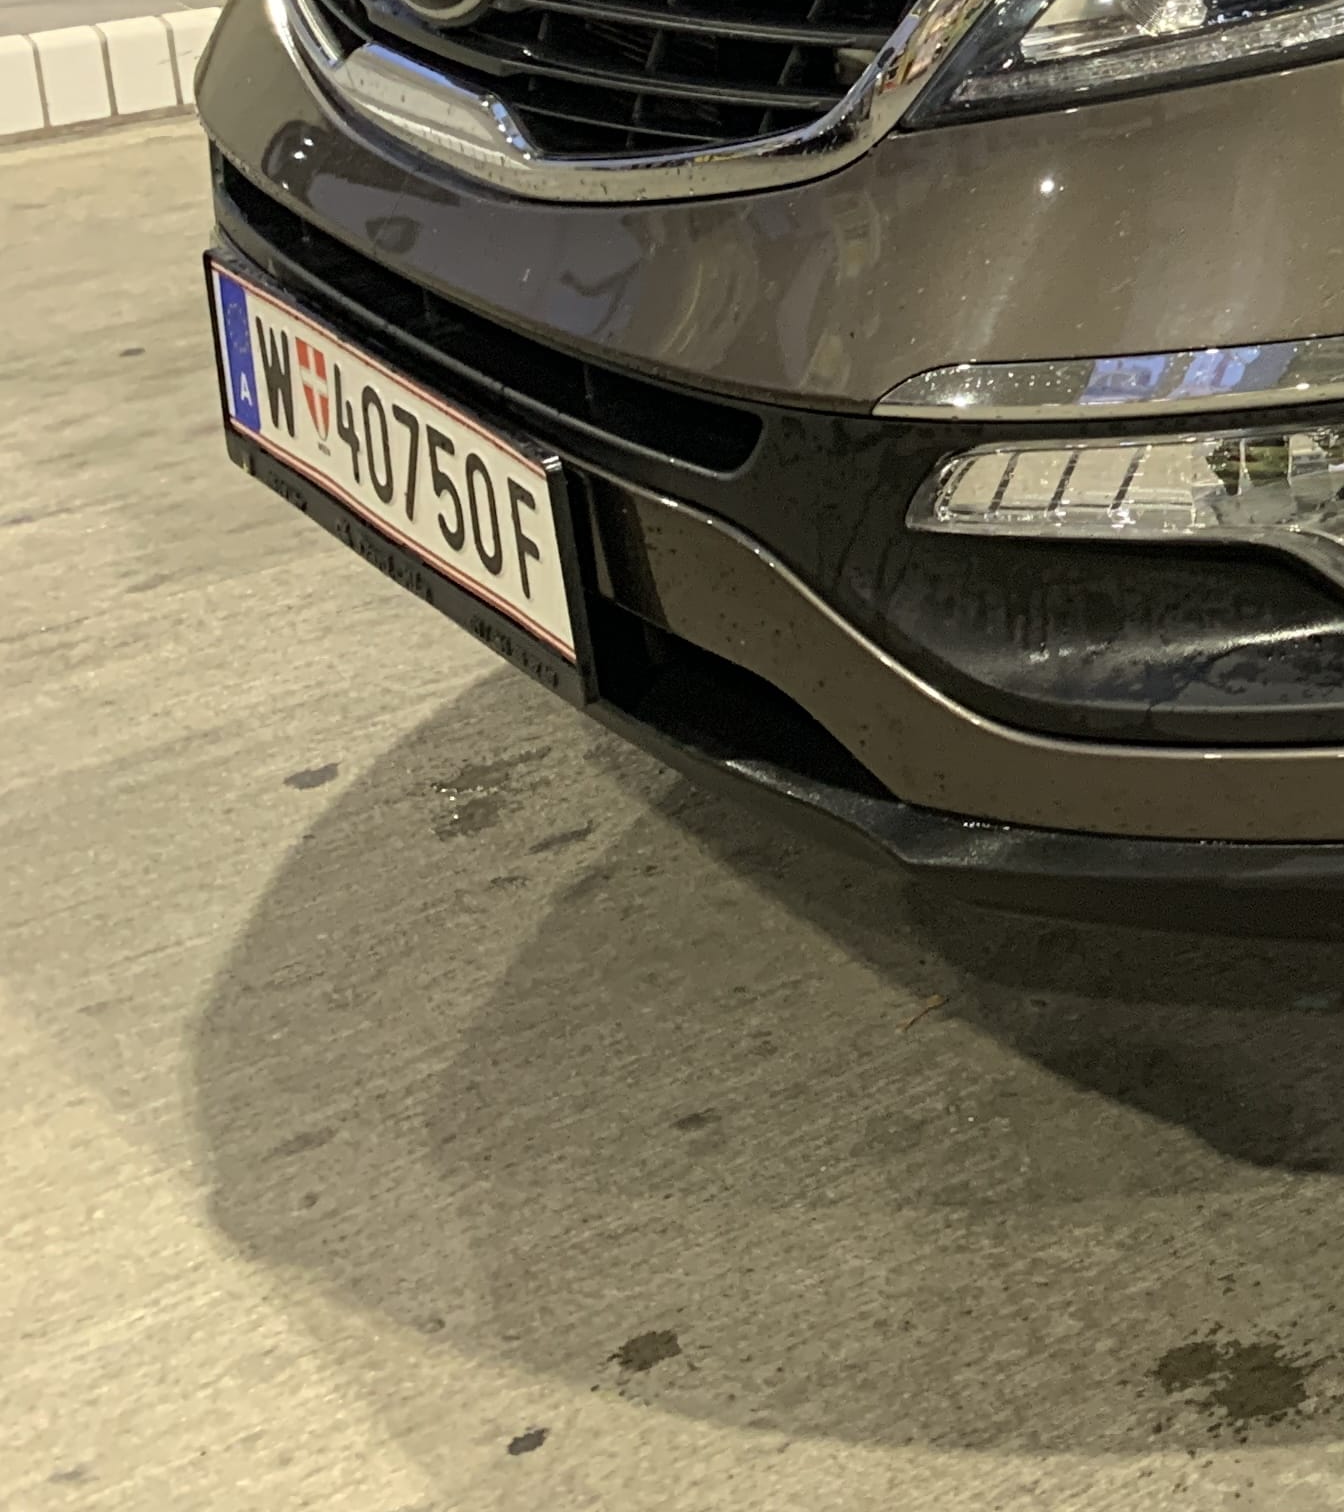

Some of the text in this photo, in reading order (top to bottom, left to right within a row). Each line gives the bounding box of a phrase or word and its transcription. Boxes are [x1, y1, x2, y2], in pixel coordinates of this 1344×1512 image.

[240, 371, 254, 407] A
[255, 316, 296, 439] W
[333, 362, 541, 601] 40750F
